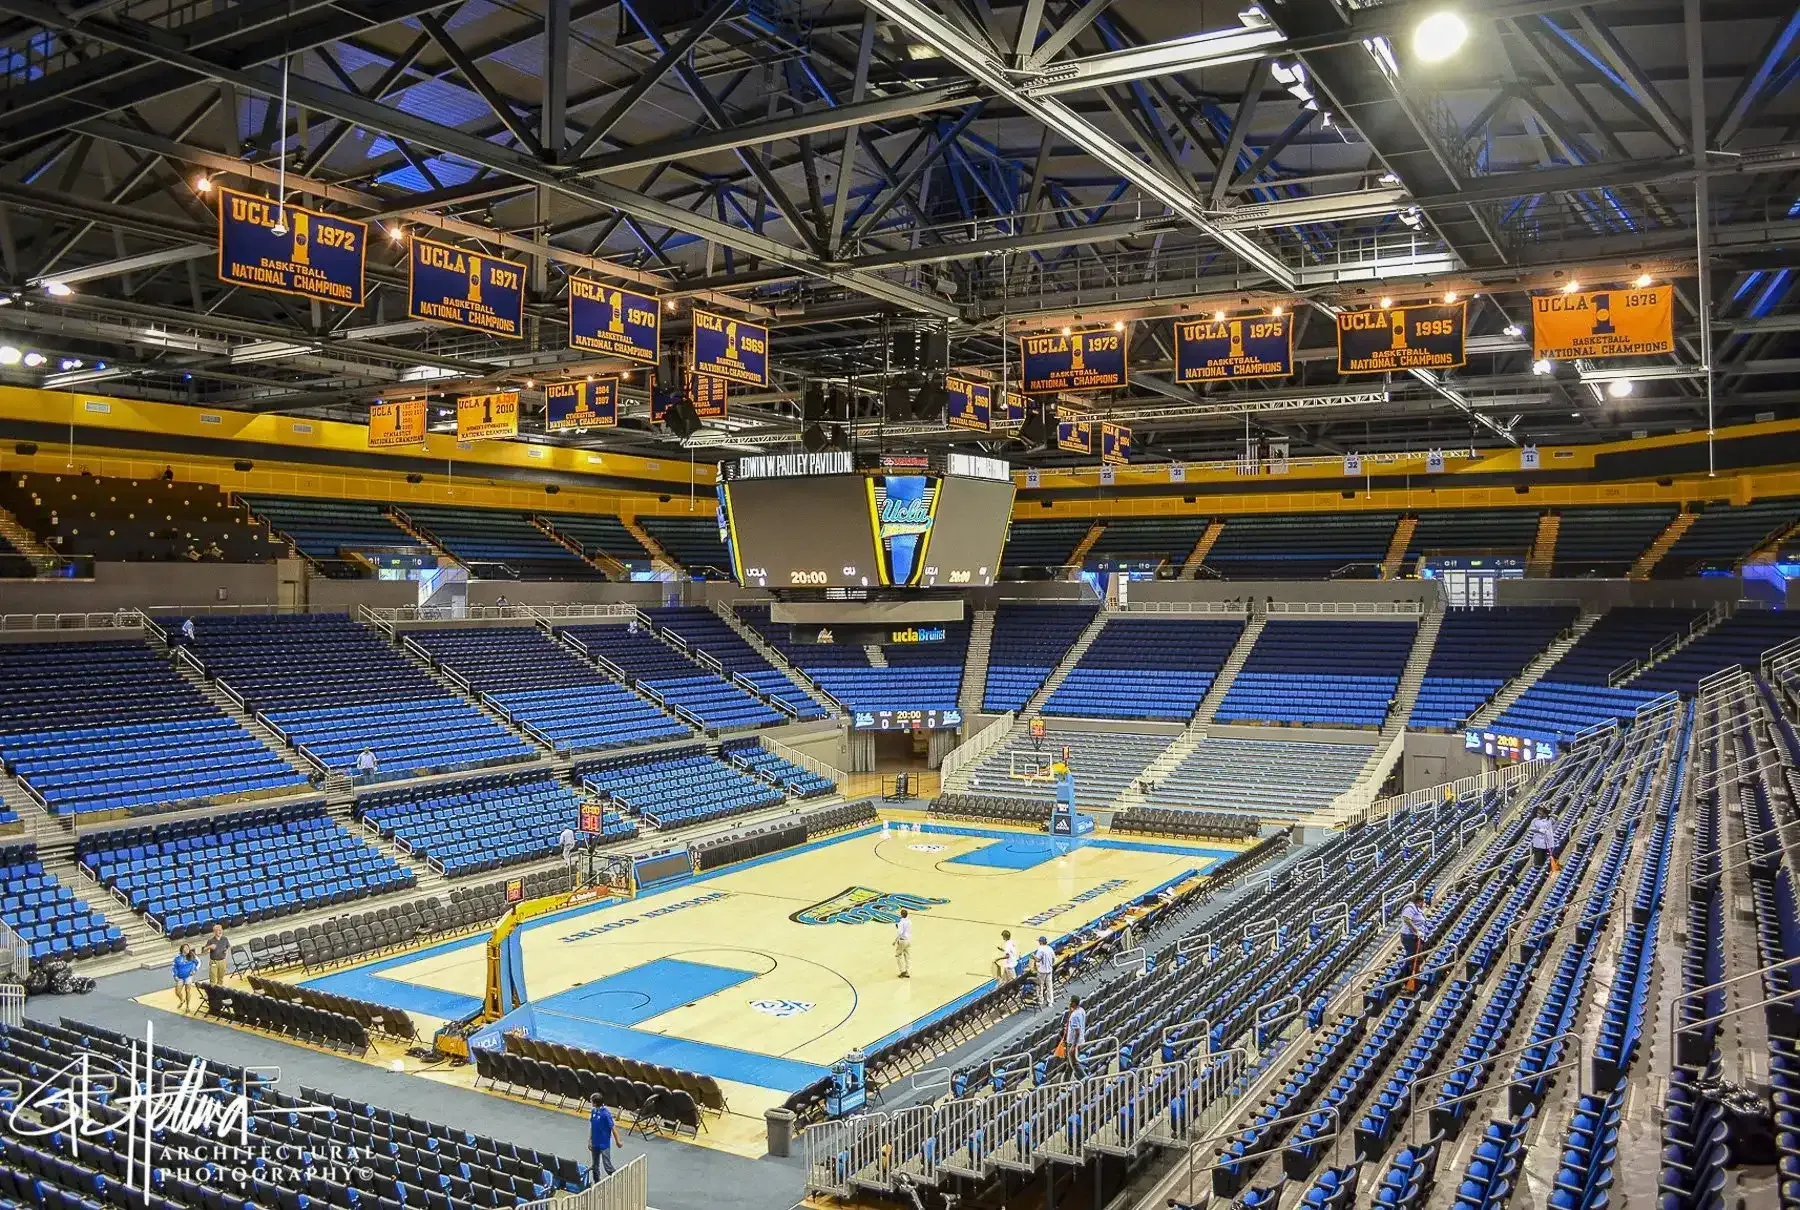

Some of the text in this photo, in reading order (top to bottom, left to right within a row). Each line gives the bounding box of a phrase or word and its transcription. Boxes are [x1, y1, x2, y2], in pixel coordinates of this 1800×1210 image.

[317, 224, 355, 251] 1972
[260, 258, 327, 280] BASKETBALL
[420, 244, 466, 274] UCLA
[490, 267, 518, 290] 1971
[231, 262, 353, 299] NATIONAL CHAMPIONS
[443, 296, 496, 315] BASKETBALL
[572, 281, 606, 303] UCLA
[627, 308, 655, 328] 1970
[1539, 296, 1589, 313] UCLA
[420, 301, 515, 332] NATIONAL CHAMPIONS
[1340, 312, 1388, 331] UCLA
[1416, 320, 1453, 336] 1995
[597, 330, 633, 344] BASKETBALL
[696, 313, 723, 332] UCLA
[741, 336, 764, 354] 1969
[1184, 322, 1228, 341] UCLA
[1250, 323, 1282, 339] 1975
[575, 334, 653, 359] NATIONAL CHAMPIONS
[1028, 338, 1069, 355] UCLA
[1088, 336, 1118, 352] 1973
[1572, 335, 1631, 346] BASKETBALL
[1372, 348, 1430, 359] BASKETBALL
[1540, 341, 1668, 358] NATIONAL CHAMPIONS
[1185, 362, 1282, 378] NATIONAL CHAMPIONS
[1207, 356, 1260, 367] BASKETBALL
[1350, 353, 1453, 370] NATIONAL CHAMPIONS
[699, 361, 762, 382] NATIONAL CHAMPIONS
[1050, 369, 1098, 379] BASKETBALL
[947, 380, 964, 393] UCLA
[1030, 374, 1118, 390] NATIONAL CHAMPIONS
[549, 385, 575, 397] UCLA
[372, 406, 392, 417] UCLA
[459, 399, 479, 409] UCLA
[496, 403, 514, 414] 2010
[580, 416, 613, 425] CHAMPIONS
[740, 457, 766, 478] EDWIN
[767, 456, 775, 476] W
[777, 454, 808, 476] PAULEY
[809, 451, 852, 474] PAVILION
[746, 568, 767, 577] UCLA
[791, 571, 827, 584] 20:00
[882, 719, 889, 729] 0
[928, 718, 935, 728] 0
[897, 711, 921, 719] 20:00
